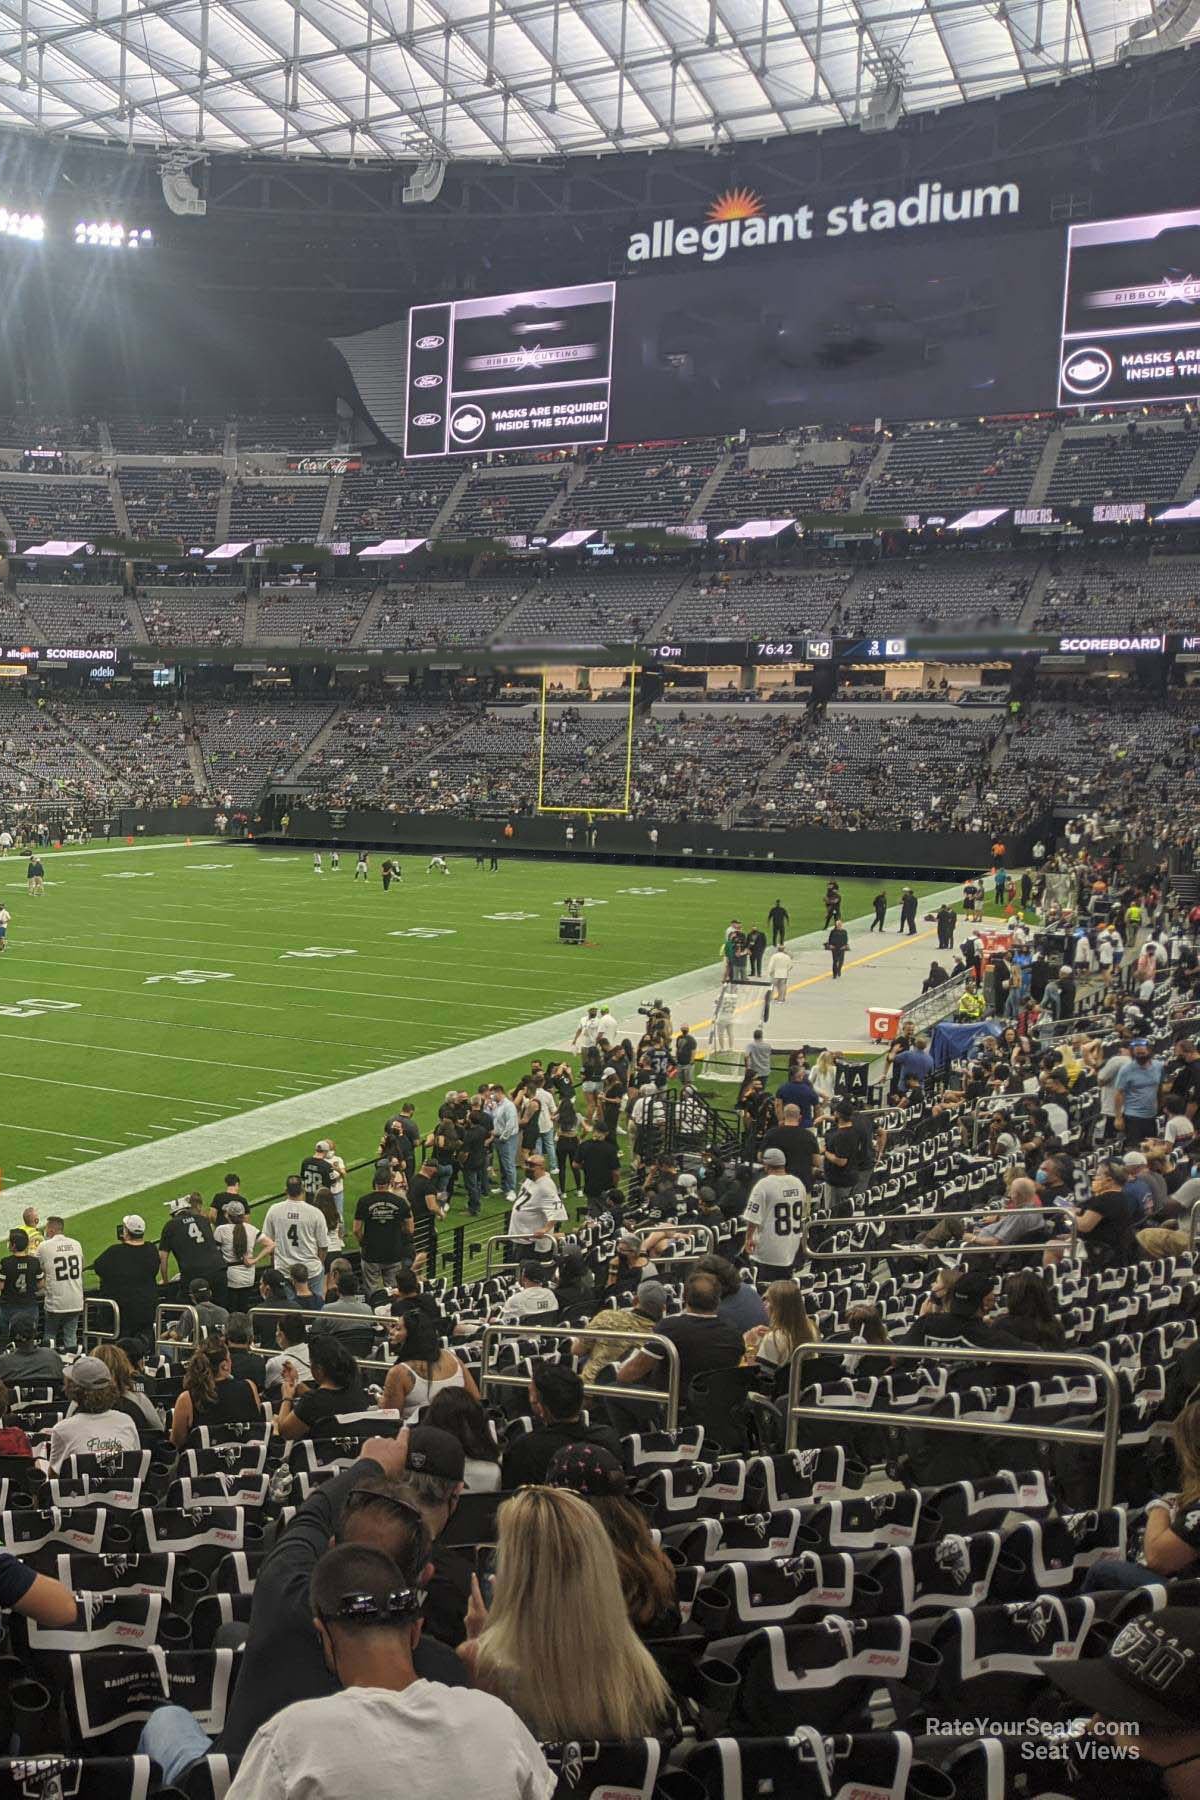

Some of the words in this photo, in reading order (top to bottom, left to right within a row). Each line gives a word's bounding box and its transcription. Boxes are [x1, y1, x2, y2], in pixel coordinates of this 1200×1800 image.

[627, 204, 814, 261] allegiant
[825, 182, 1020, 237] stadium
[1115, 289, 1166, 301] RIBBON
[1121, 351, 1172, 367] MASKS
[1127, 366, 1174, 380] INSIDE
[491, 407, 528, 420] MASKS
[531, 406, 552, 417] ARE
[553, 401, 608, 415] REQUIRED
[495, 420, 530, 432] INSIDE
[533, 418, 552, 429] THE
[554, 413, 603, 426] STADIUM
[1014, 508, 1053, 525] RAIDERS
[659, 645, 682, 657] QTR
[758, 644, 793, 655] 76:42
[809, 642, 829, 657] 40
[871, 640, 879, 650] 3
[1059, 638, 1161, 651] SCOREBOARD
[6, 650, 39, 659] allegiant
[46, 649, 114, 660] SCOREBOARD
[874, 1017, 889, 1032] G
[852, 1072, 862, 1087] A
[774, 1200, 803, 1237] 89
[188, 1223, 206, 1244] 4
[286, 1224, 300, 1247] 4
[53, 1254, 80, 1282] 28
[15, 1273, 27, 1293] 4
[104, 1672, 140, 1689] RAIDERS
